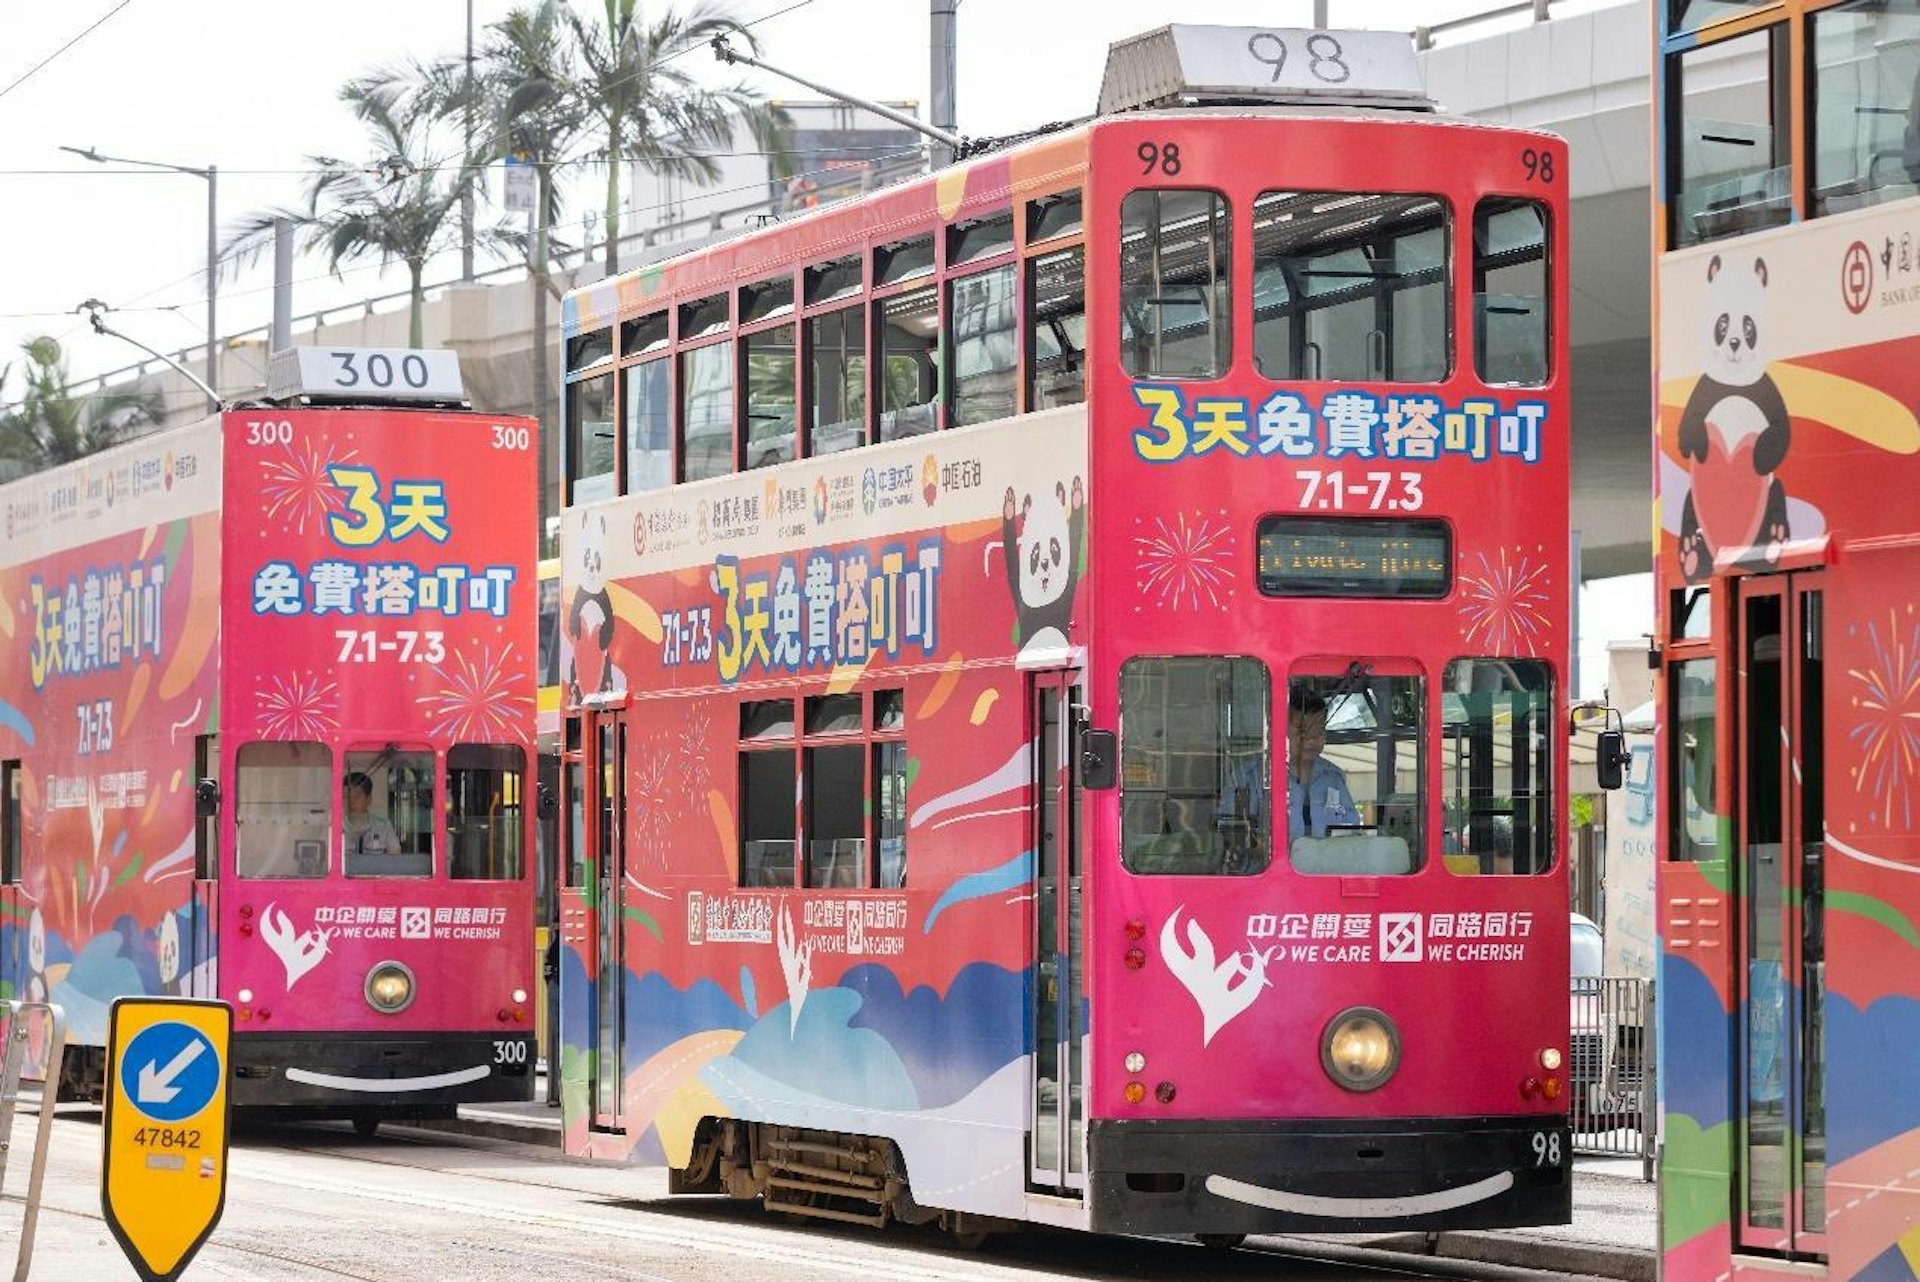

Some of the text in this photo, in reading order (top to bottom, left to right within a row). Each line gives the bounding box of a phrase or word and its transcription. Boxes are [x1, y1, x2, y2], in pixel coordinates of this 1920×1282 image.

[1248, 33, 1351, 84] 98
[1137, 143, 1181, 176] 98
[1522, 149, 1554, 184] 98
[331, 352, 429, 389] 300
[247, 421, 293, 444] 300
[492, 425, 530, 450] 300
[1132, 383, 1549, 465] 3天免費搭叮叮
[327, 464, 451, 547] 3天
[1296, 471, 1424, 511] 7.1-7.3
[252, 562, 520, 618] 免費搭叮叮
[28, 554, 167, 690] 3天免費搭叮叮
[714, 539, 942, 685] 3天免費搭叮叮
[336, 631, 445, 664] 7.1-7.3
[434, 907, 507, 925] 同路同行
[1246, 913, 1372, 939] 中企關愛
[1428, 912, 1532, 938] 同路同行
[344, 927, 397, 940] WE CARE
[434, 927, 501, 940] WE CHERISH
[1291, 946, 1372, 962] WE CARE
[1428, 944, 1525, 962] WE CHERISH
[493, 1041, 527, 1065] 300
[134, 1127, 201, 1149] 47842
[1532, 1132, 1562, 1167] 98
